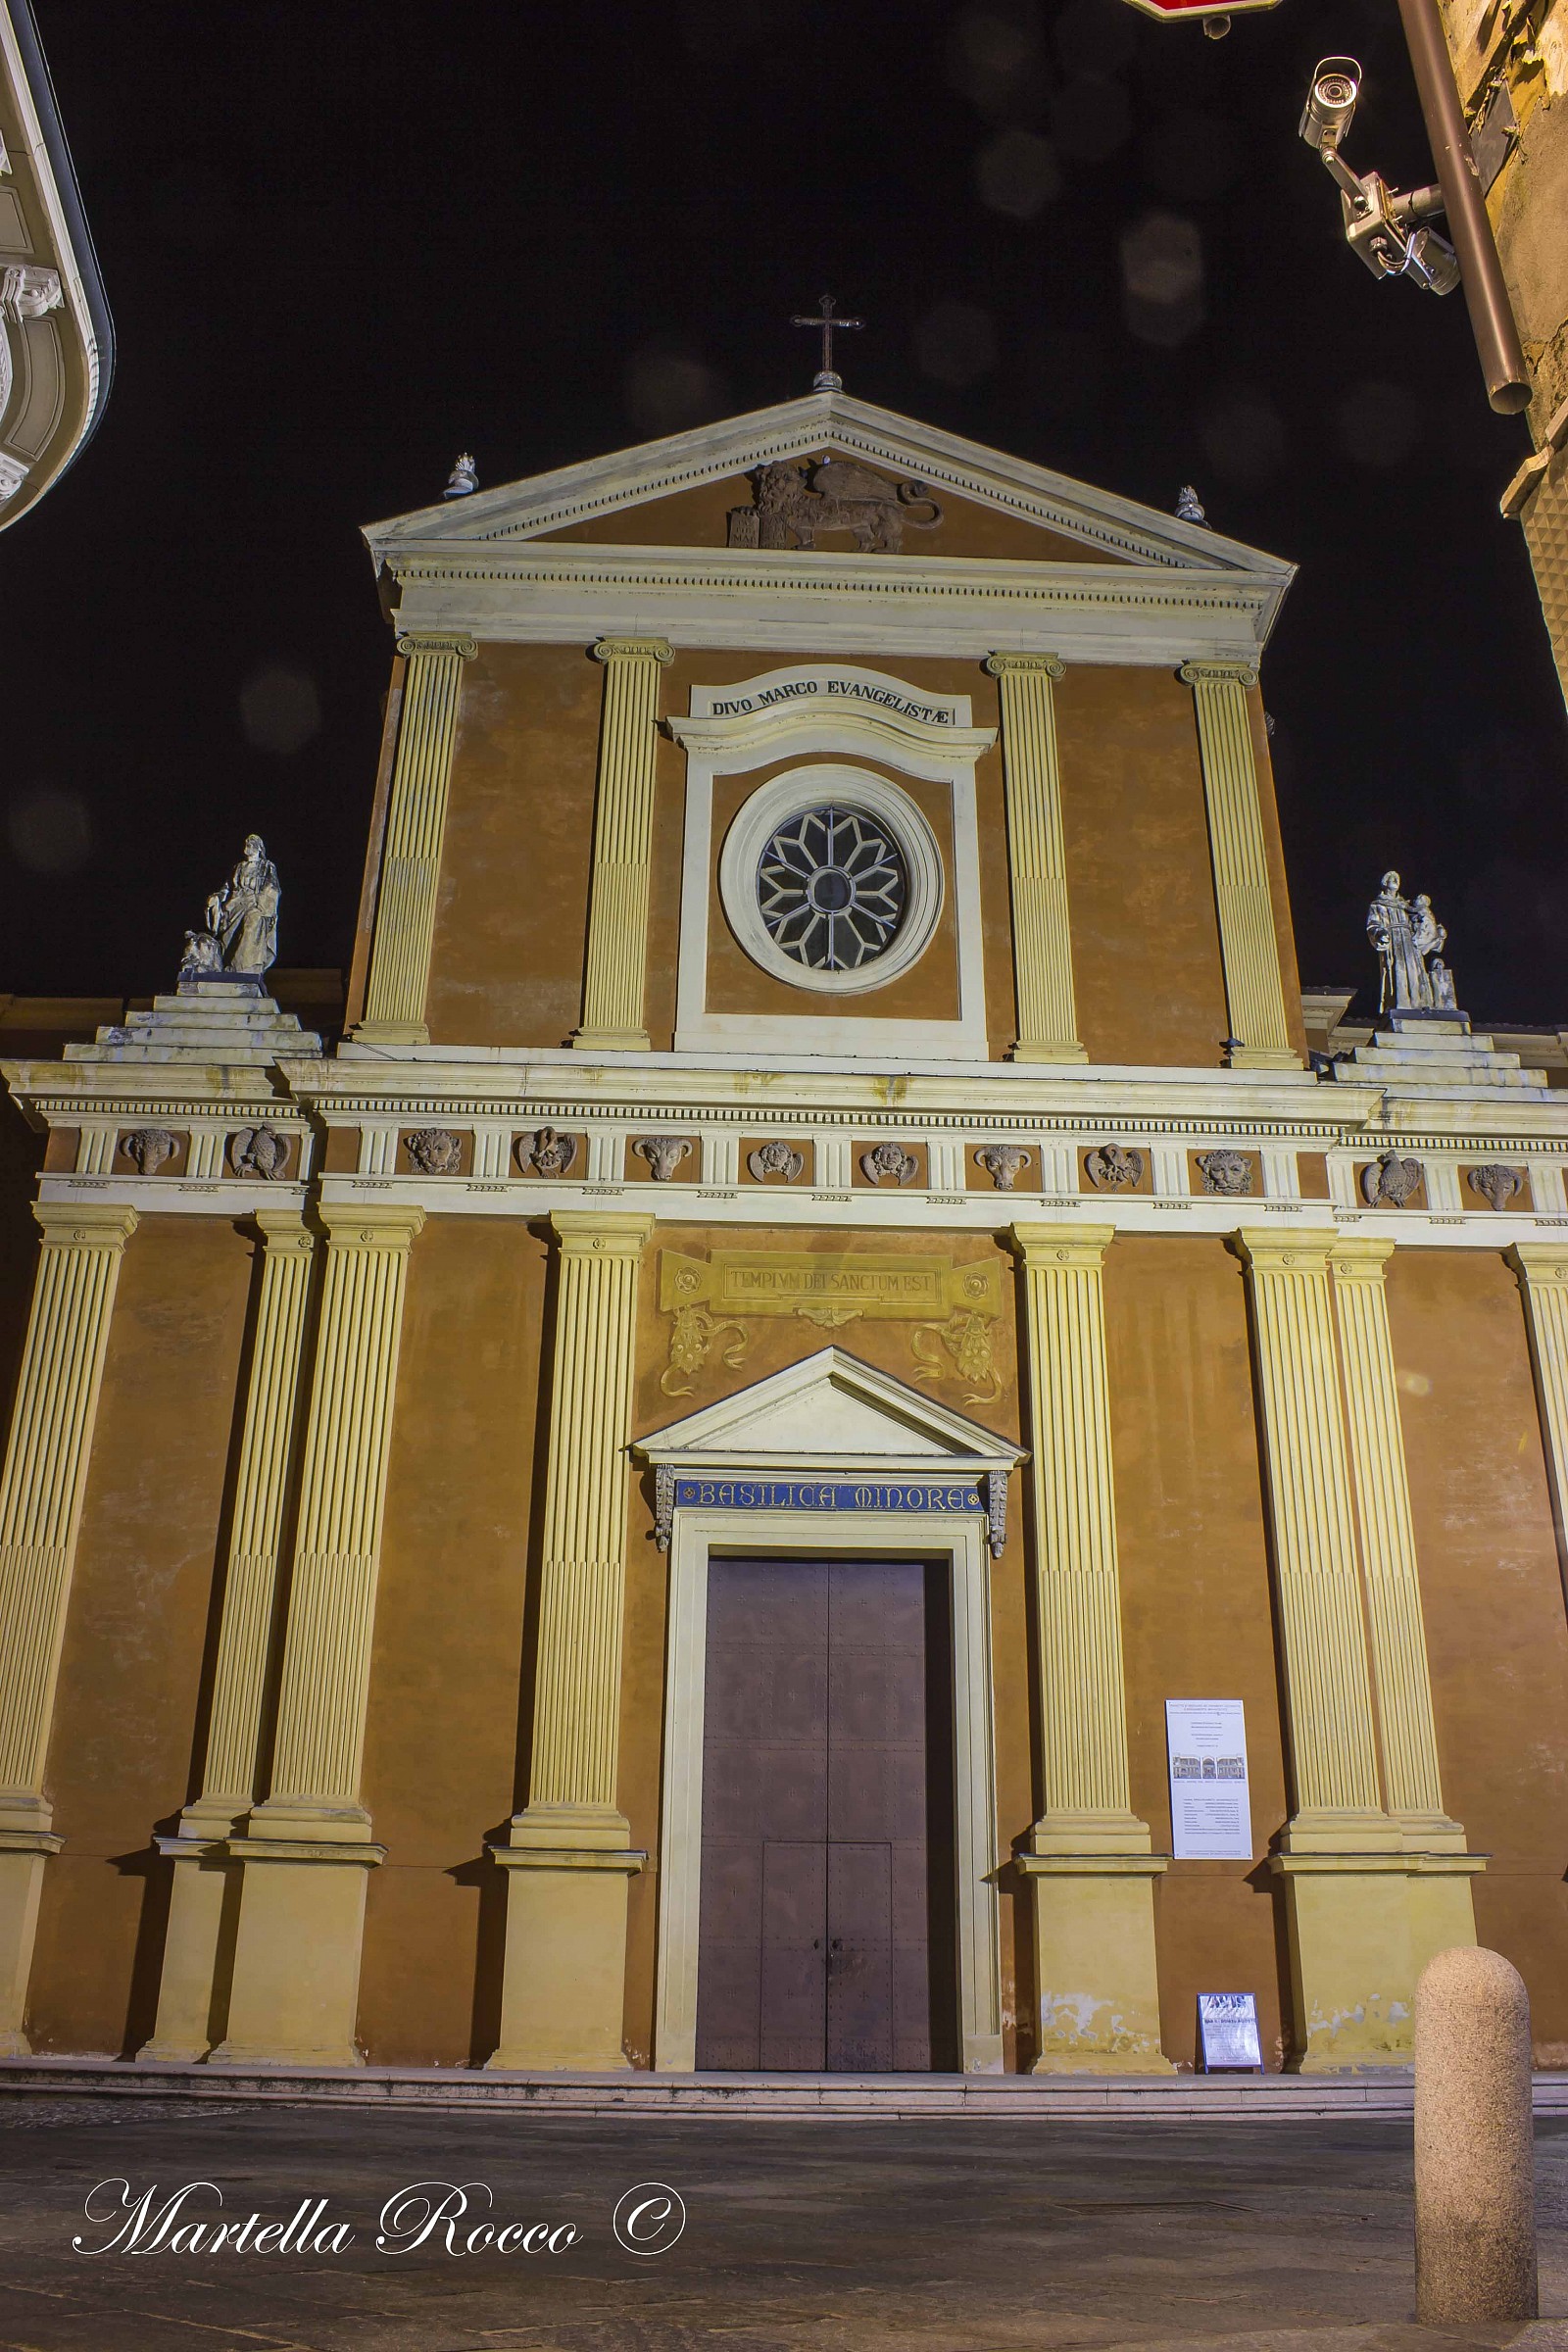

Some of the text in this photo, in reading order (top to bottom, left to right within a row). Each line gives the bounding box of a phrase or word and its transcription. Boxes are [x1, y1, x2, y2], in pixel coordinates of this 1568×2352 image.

[712, 680, 950, 724] DIVO MARCO EVANGELISTÆ
[804, 1272, 826, 1290] DEI
[830, 1273, 900, 1292] SANCTUM
[903, 1275, 931, 1292] EST
[697, 1482, 966, 1510] BASILICA MINORE
